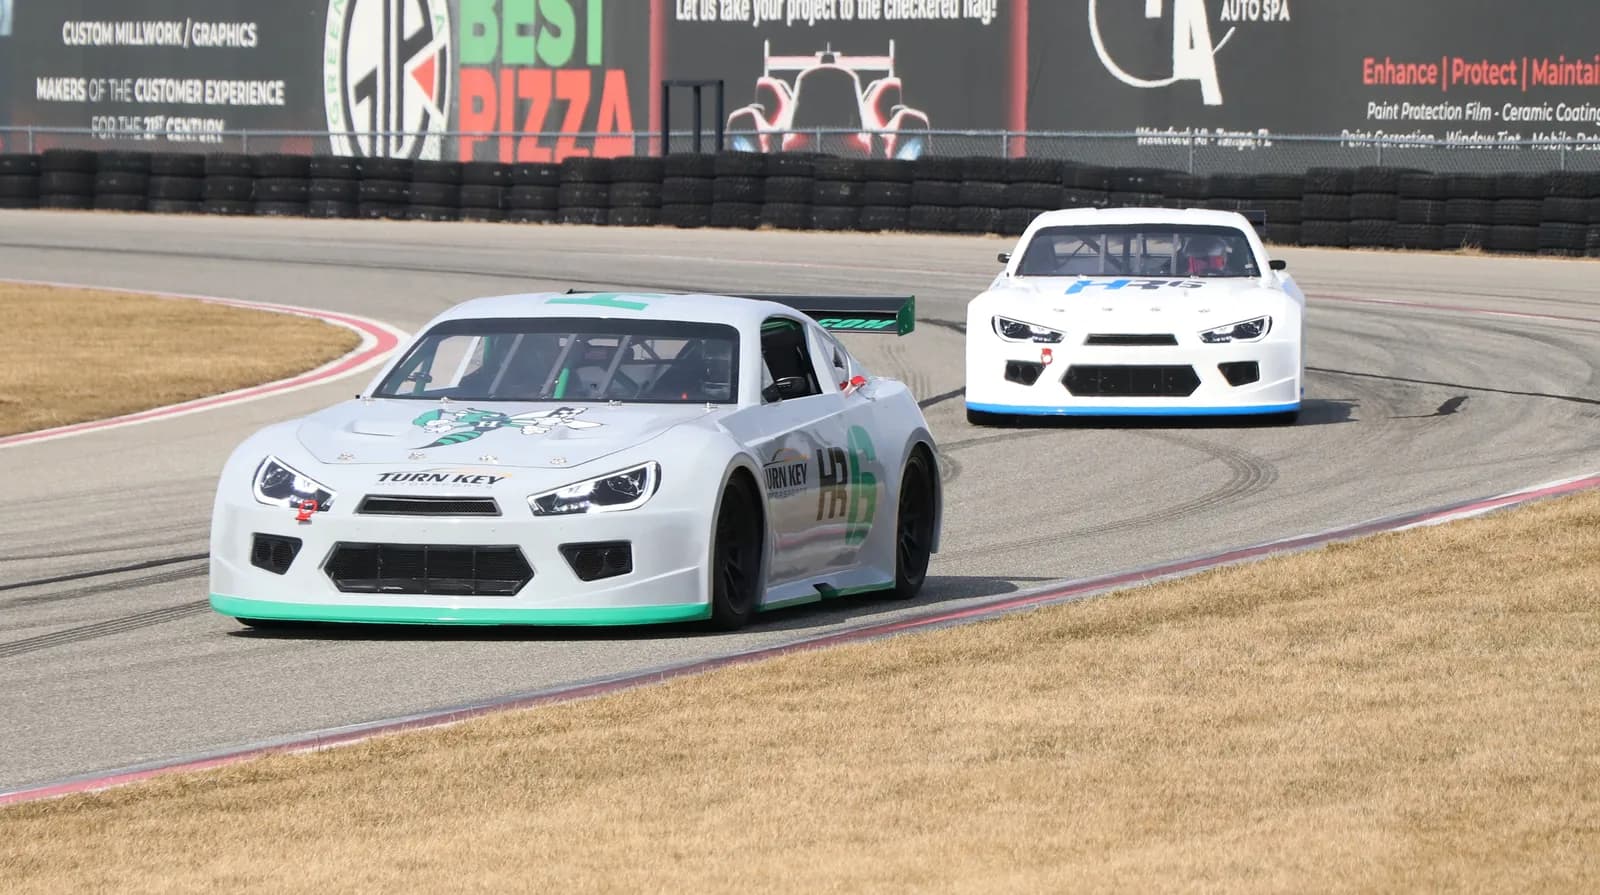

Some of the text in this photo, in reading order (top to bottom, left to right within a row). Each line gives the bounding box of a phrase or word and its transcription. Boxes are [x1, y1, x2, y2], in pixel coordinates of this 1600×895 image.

[675, 0, 998, 27] Let us take your project to the checkered flag!
[1220, 0, 1291, 22] AUTO SPA
[62, 20, 114, 46] CUSTOM
[114, 21, 183, 46] MILLWORK
[192, 22, 258, 48] GRAPHICS
[1362, 56, 1438, 86] Enhance
[1452, 57, 1518, 86] Protect
[36, 77, 286, 106] MAKERS OF THE CUSTOMER EXPERIENCE
[458, 68, 634, 164] PIZZA
[1367, 101, 1399, 121] Paint
[1401, 101, 1462, 121] Protection
[1465, 101, 1492, 121] Film
[1502, 102, 1553, 122] Ceramic
[91, 115, 116, 140] FOR
[118, 115, 142, 140] THE
[166, 116, 225, 143] CENTURY
[376, 472, 505, 485] TURN KEY
[787, 463, 808, 487] KEY
